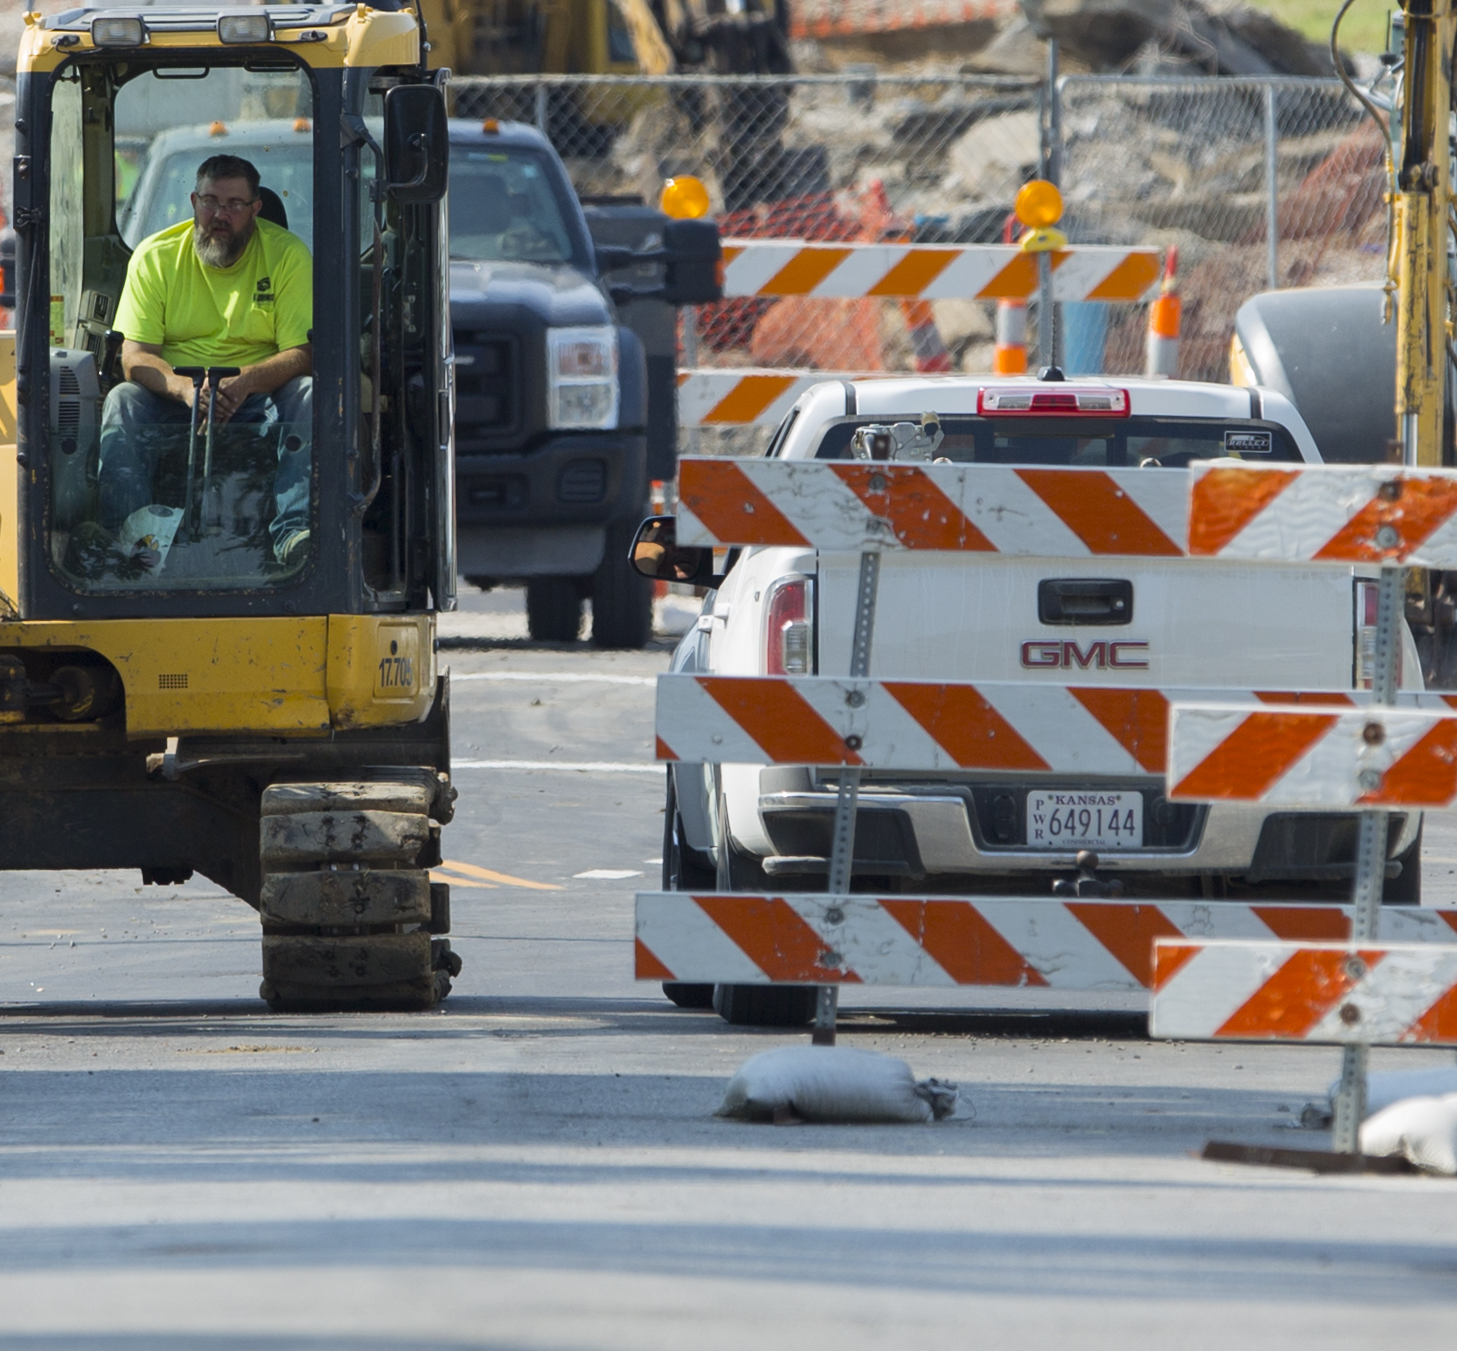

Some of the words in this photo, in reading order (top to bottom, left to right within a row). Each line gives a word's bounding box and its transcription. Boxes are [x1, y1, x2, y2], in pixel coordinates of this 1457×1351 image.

[1021, 639, 1150, 670] GMC
[379, 657, 413, 687] 17.705
[1055, 795, 1116, 806] KANSAS
[1049, 809, 1135, 836] 649144
